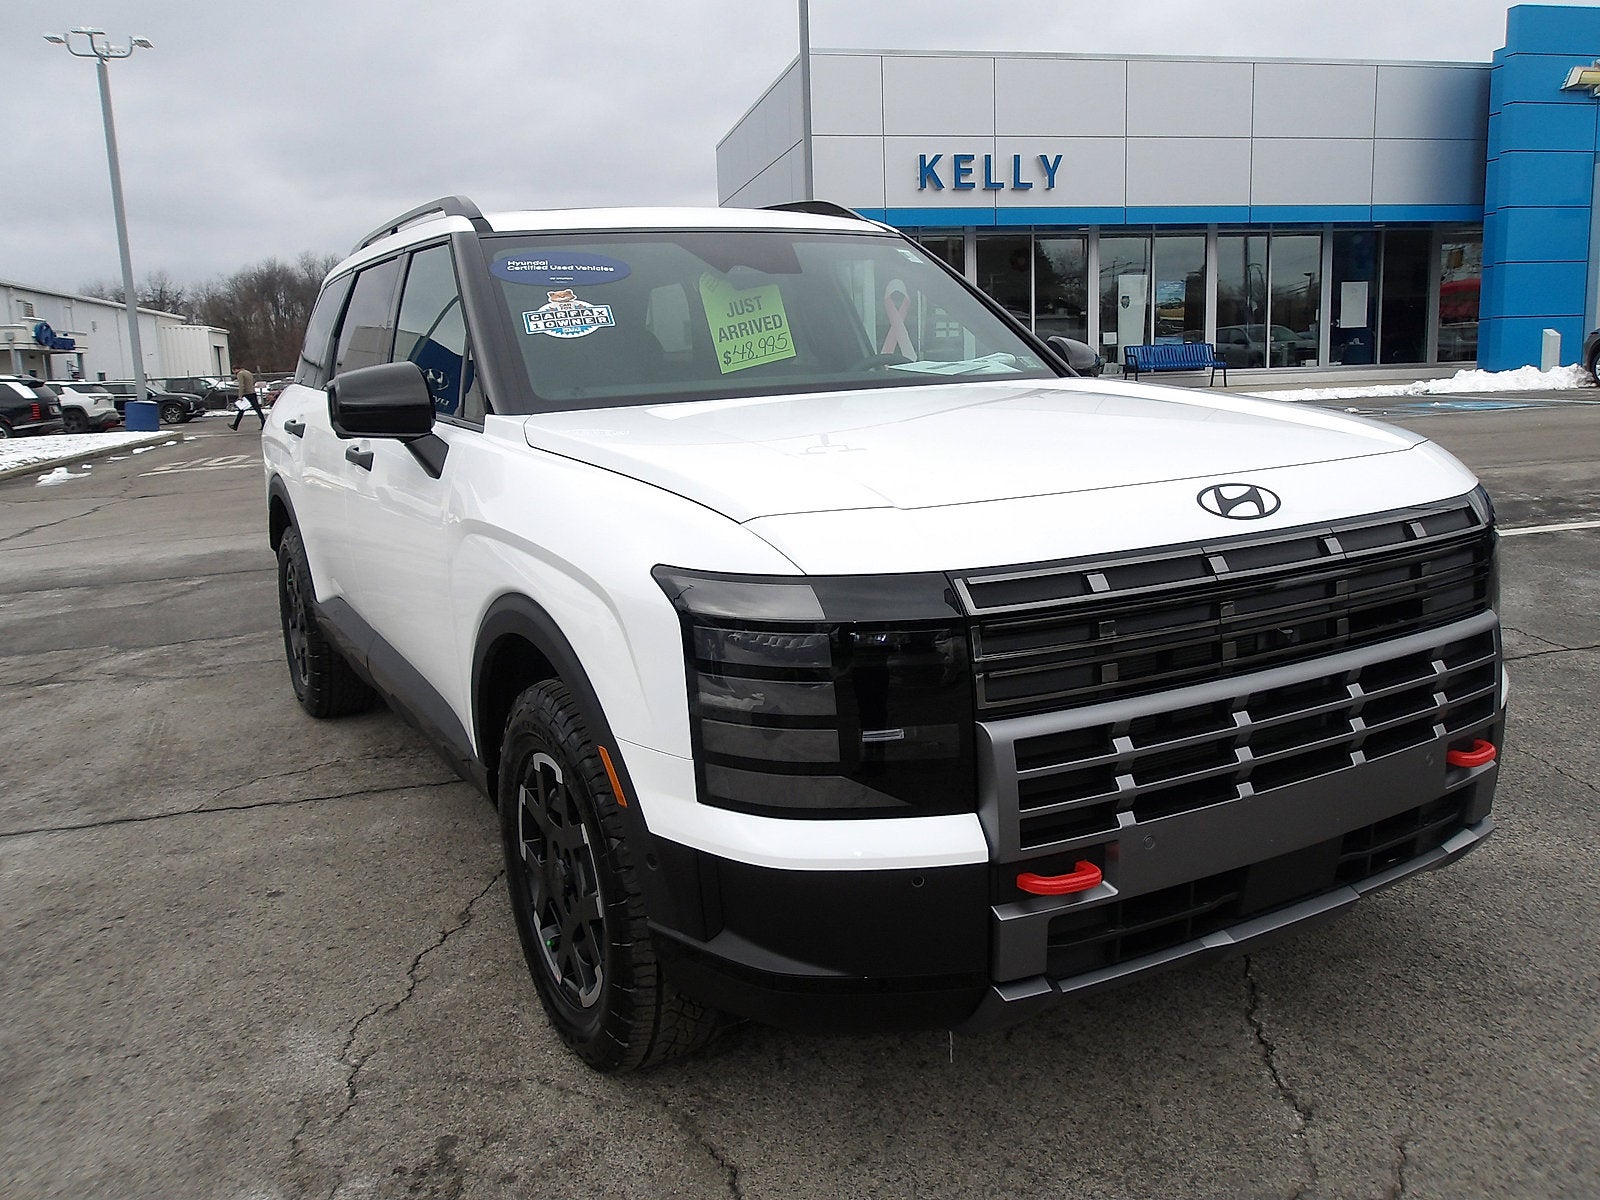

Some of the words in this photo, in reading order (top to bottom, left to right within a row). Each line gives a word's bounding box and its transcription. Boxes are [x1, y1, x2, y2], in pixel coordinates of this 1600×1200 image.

[917, 153, 1064, 191] KELLY
[530, 309, 604, 321] CARFAX
[726, 295, 762, 318] JUST
[718, 314, 783, 343] ARRIVED
